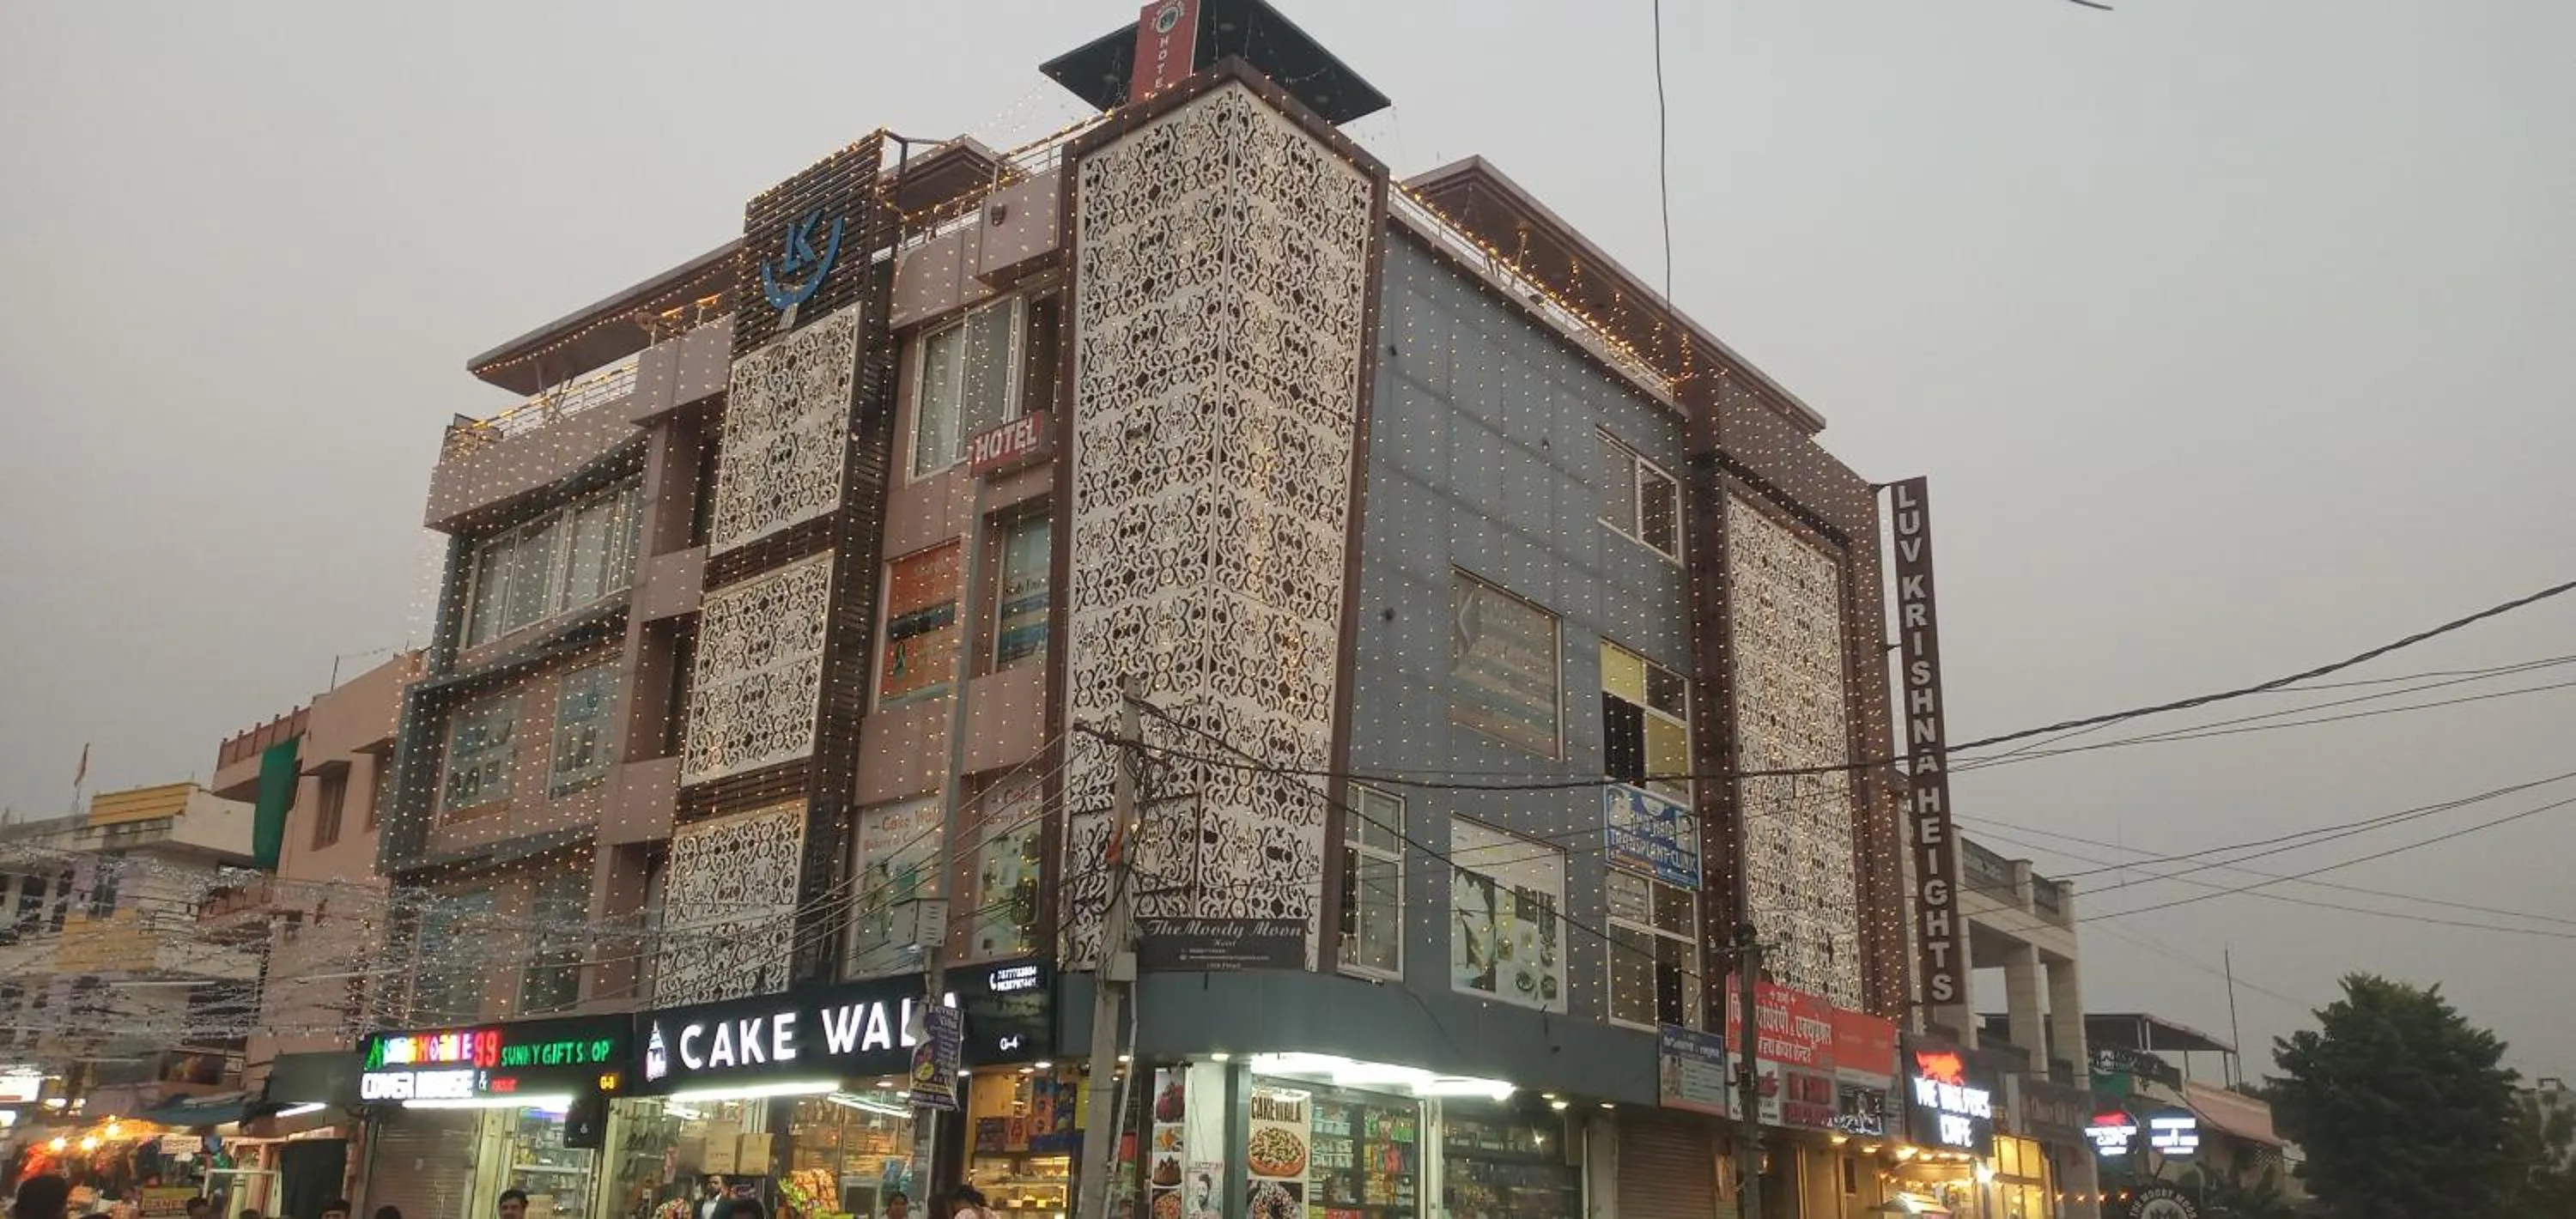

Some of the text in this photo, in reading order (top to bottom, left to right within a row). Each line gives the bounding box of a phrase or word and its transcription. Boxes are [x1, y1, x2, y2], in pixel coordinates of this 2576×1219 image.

[1155, 35, 1170, 89] HOTE
[975, 416, 1037, 464] HOTEL
[1898, 485, 1953, 1002] LUV KRISHNA HEIGHTS
[1181, 919, 1244, 939] Moody
[1250, 920, 1302, 937] Moon
[679, 1011, 798, 1070] CAKE
[821, 992, 957, 1056] WAL
